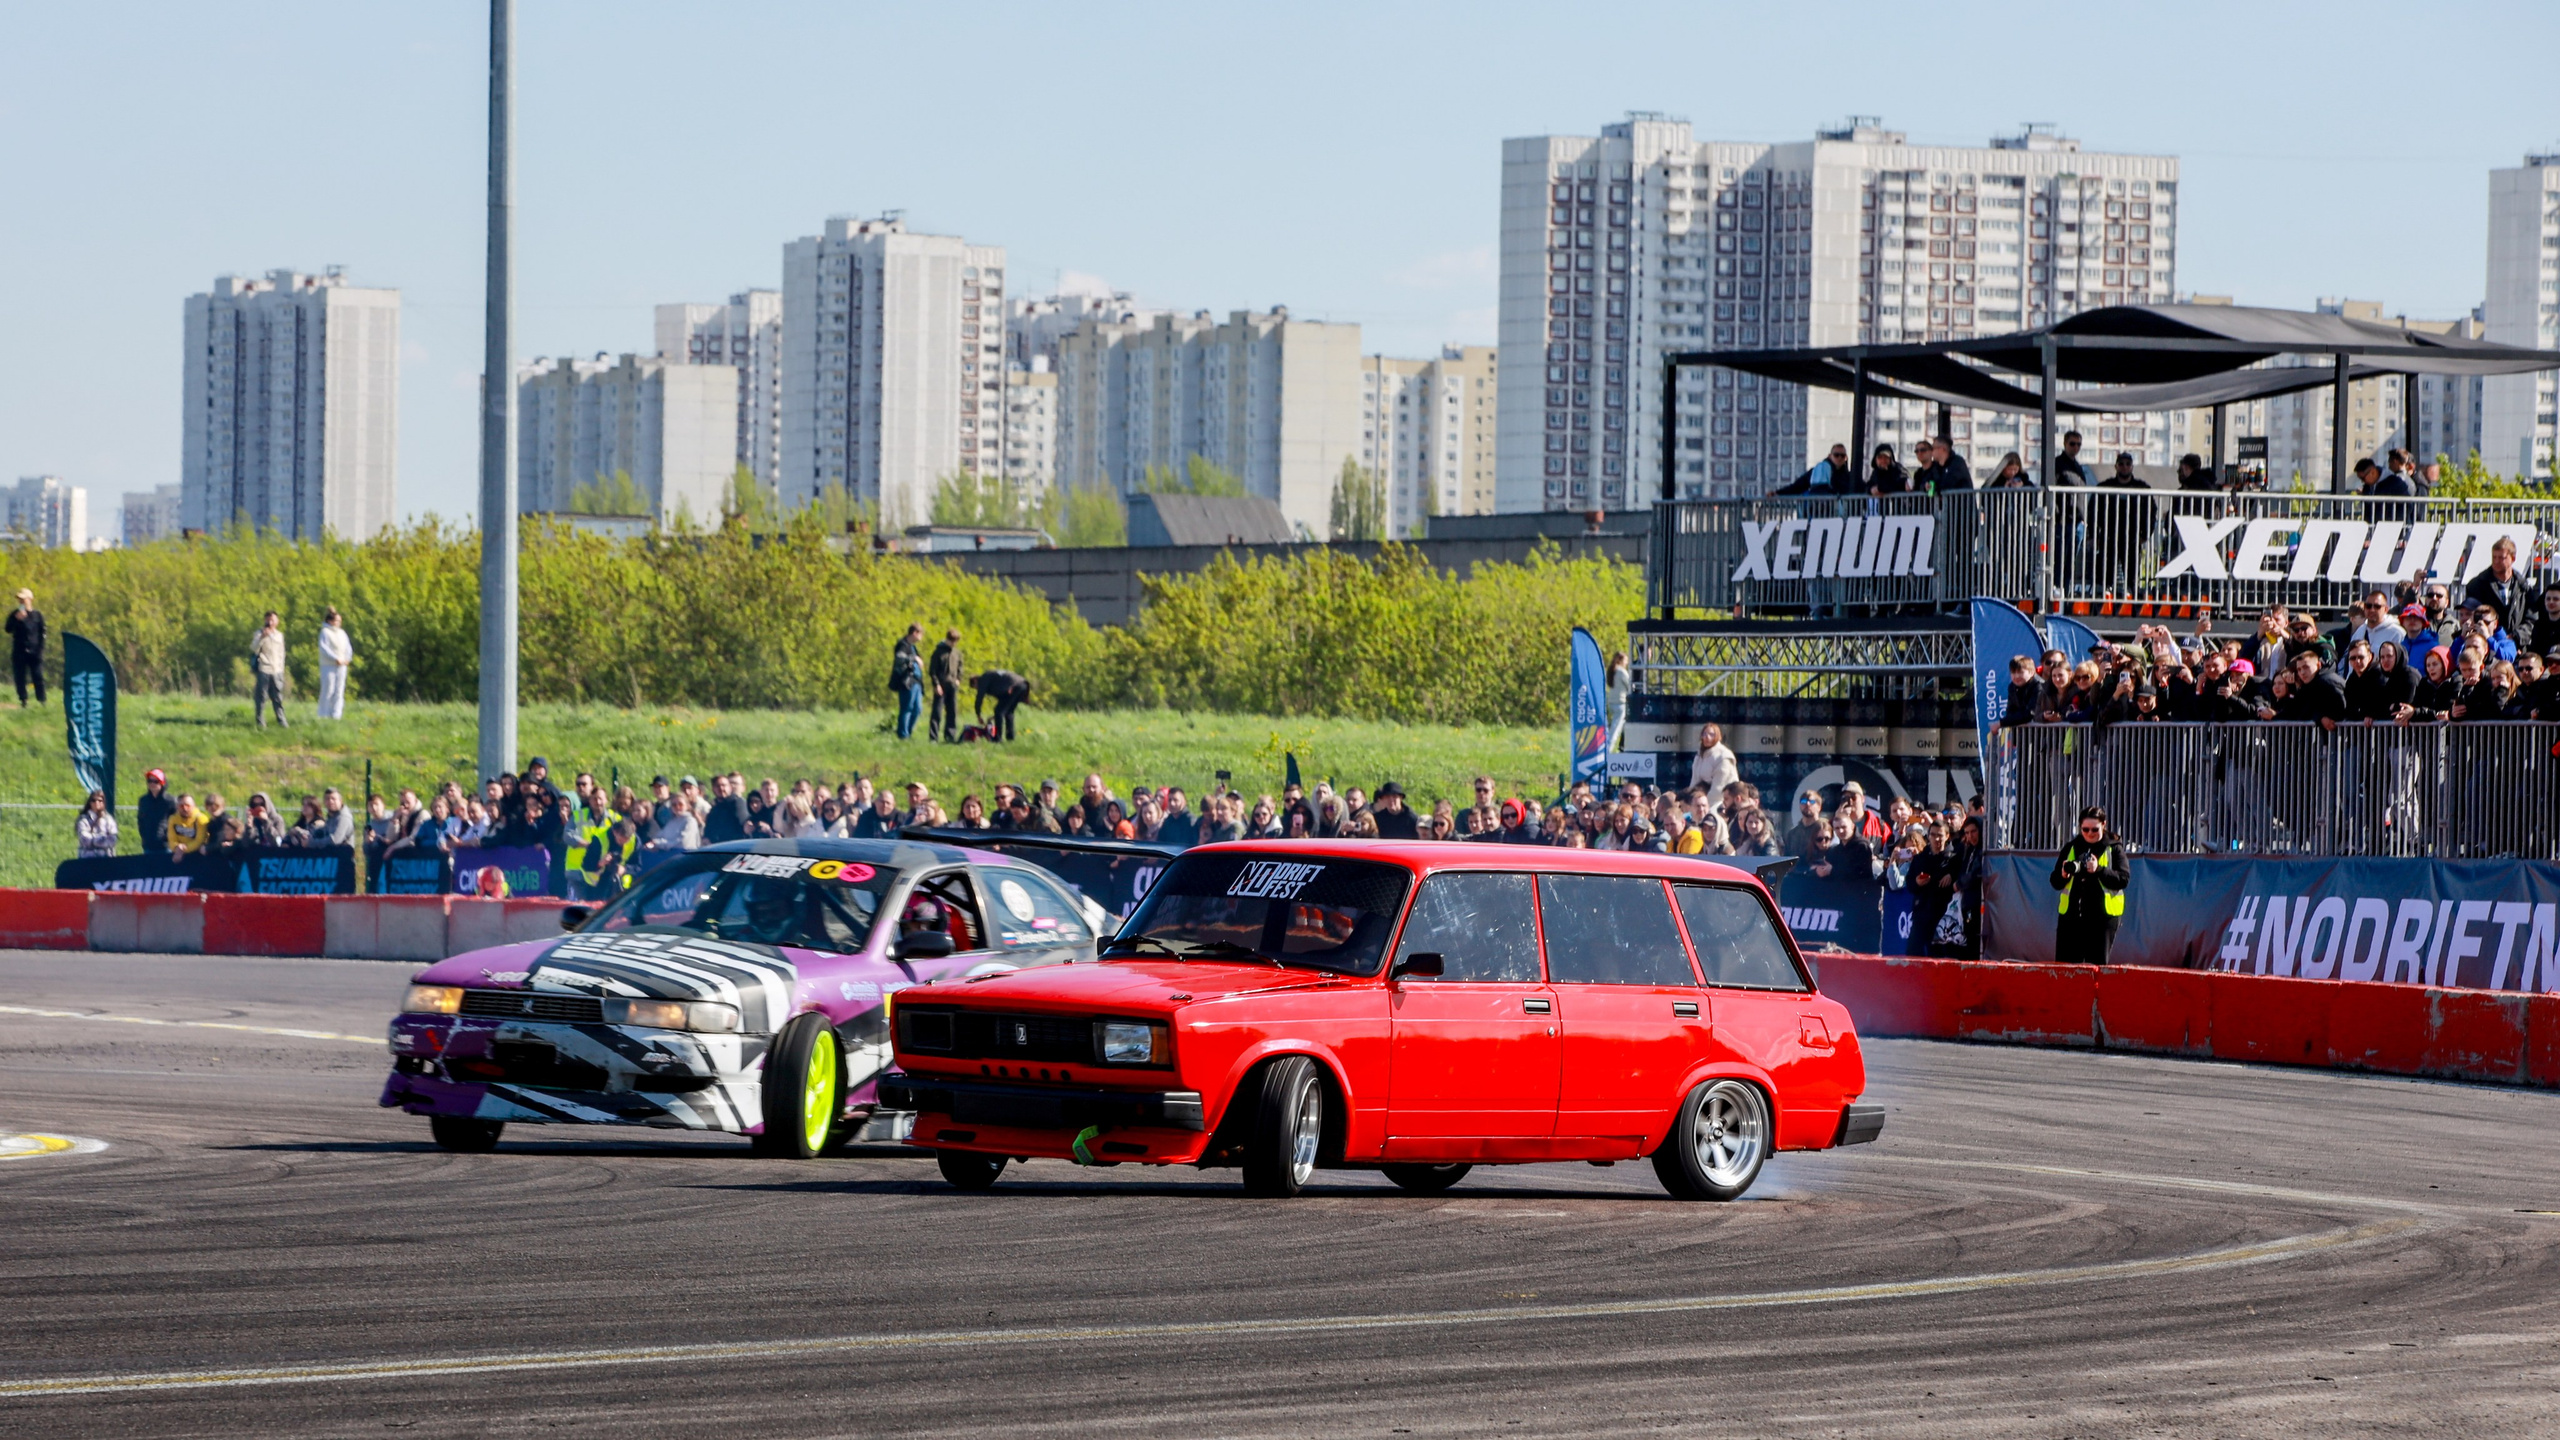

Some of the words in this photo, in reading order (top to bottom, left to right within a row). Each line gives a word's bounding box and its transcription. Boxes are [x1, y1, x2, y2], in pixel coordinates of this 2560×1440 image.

[1731, 515, 1935, 582] XENUM
[2155, 515, 2537, 585] XENUM
[1655, 735, 1674, 744] GNV
[1760, 736, 1780, 746] GNV
[1807, 737, 1829, 746] GNV
[1857, 738, 1879, 747] GNV
[1916, 739, 1936, 749] GNV
[1610, 762, 1633, 772] GNV
[258, 857, 339, 878] TSUNAMI
[1273, 862, 1327, 884] DRIFT
[1261, 880, 1307, 900] FEST
